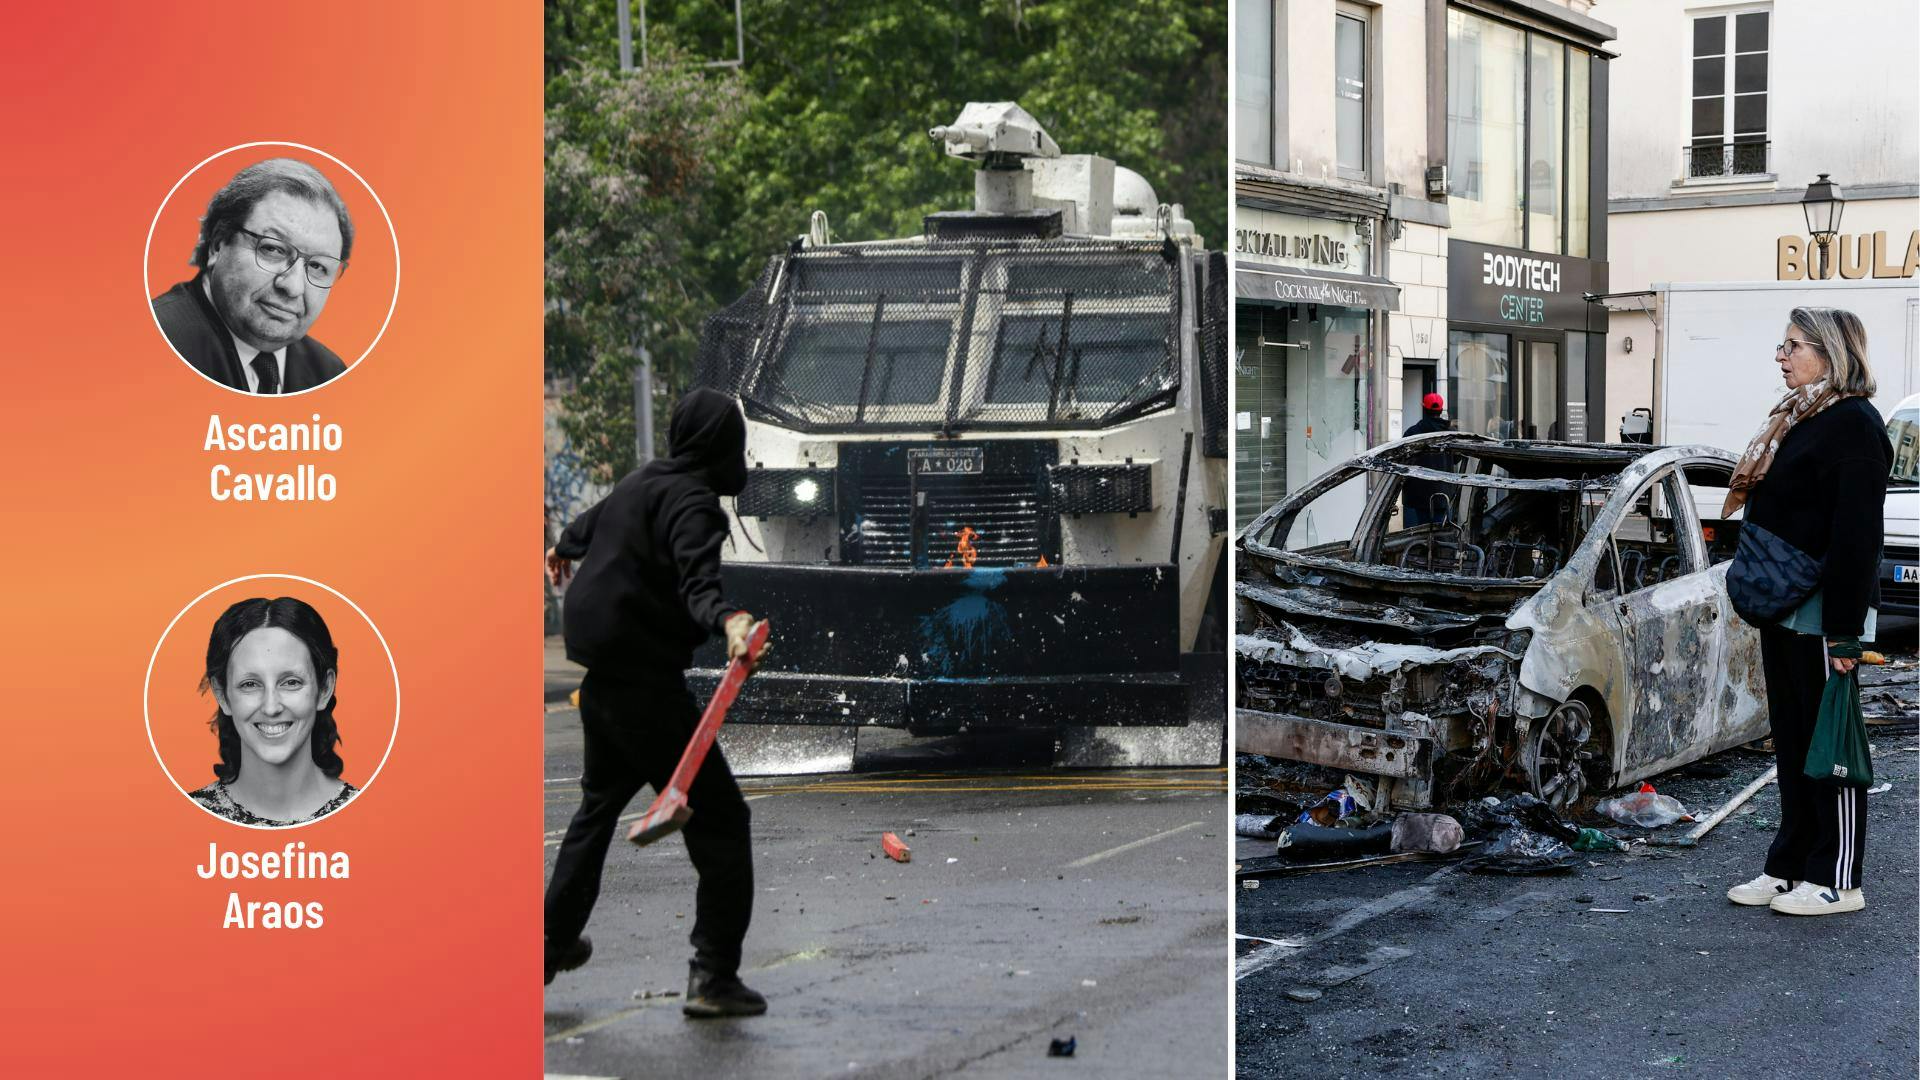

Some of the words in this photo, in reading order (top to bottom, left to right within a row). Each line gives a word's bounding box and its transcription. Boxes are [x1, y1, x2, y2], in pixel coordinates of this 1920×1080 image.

[1294, 235, 1312, 259] BY
[1483, 252, 1560, 293] BODYTECH
[1274, 280, 1321, 300] COCKTAIL
[1500, 294, 1544, 322] CENTER
[946, 458, 973, 472] 020
[1903, 568, 1919, 580] AA
